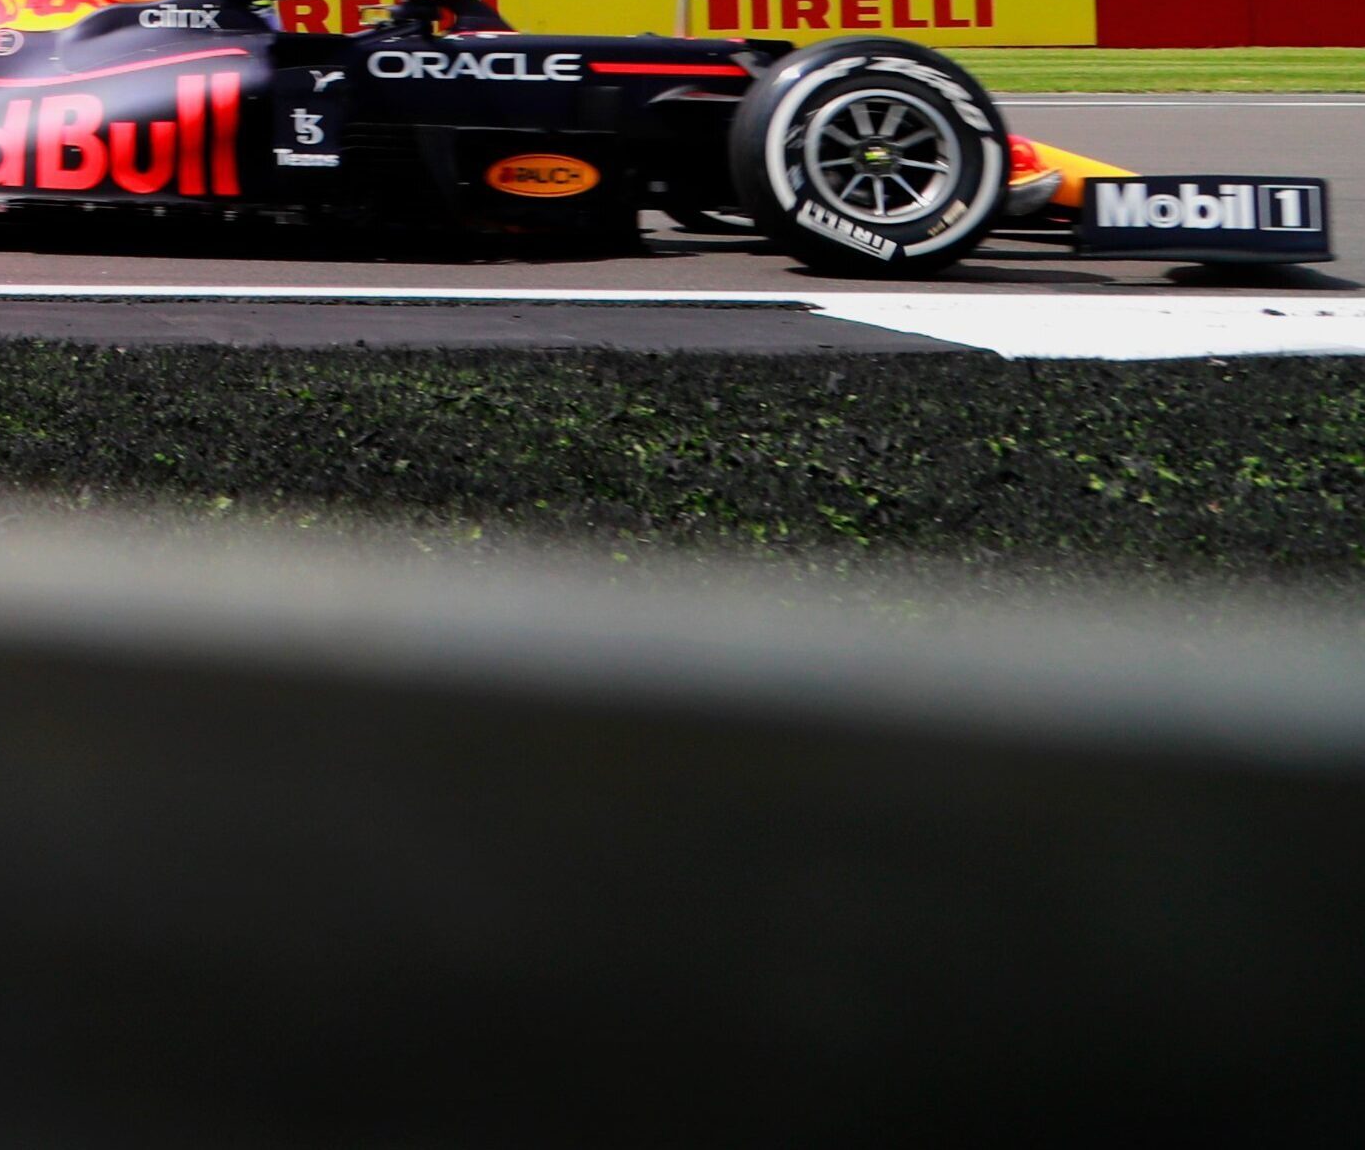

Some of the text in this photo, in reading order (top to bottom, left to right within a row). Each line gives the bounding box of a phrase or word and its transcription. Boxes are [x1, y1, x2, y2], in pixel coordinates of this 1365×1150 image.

[367, 50, 582, 82] ORACLE
[35, 71, 241, 196] Bull
[796, 199, 898, 262] PIRELLI
[1095, 182, 1302, 230] Mobil 1
